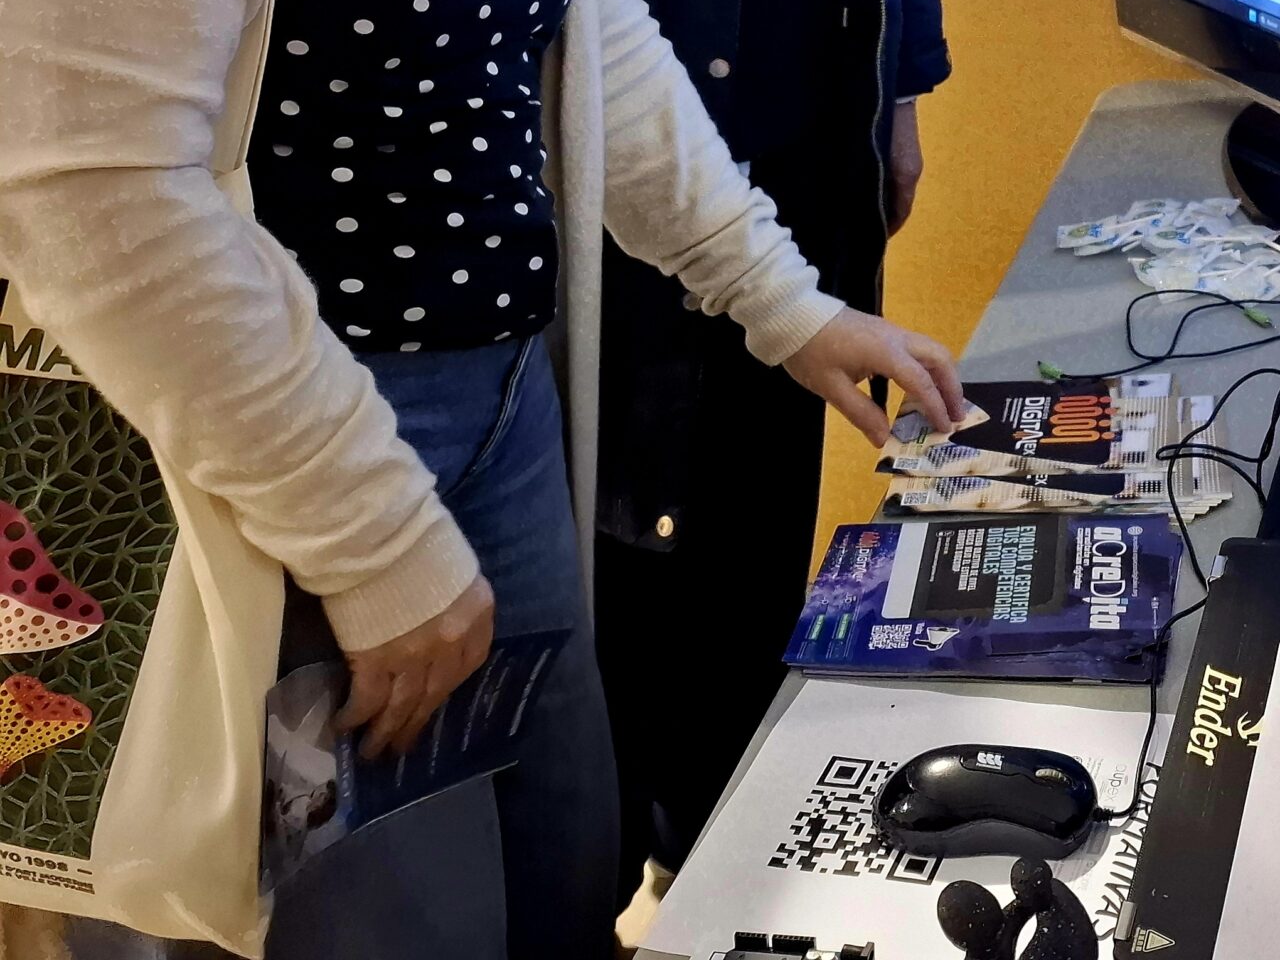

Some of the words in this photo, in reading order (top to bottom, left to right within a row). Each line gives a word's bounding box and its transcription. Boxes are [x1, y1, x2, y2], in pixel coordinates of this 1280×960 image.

[983, 528, 1004, 574] DIGITALES
[1004, 526, 1020, 543] TUS
[1017, 526, 1038, 561] EVALÚA
[993, 548, 1017, 620] COMPETENCIAS
[1009, 575, 1031, 623] CERTIFICA
[1082, 527, 1128, 629] aCreDita
[1186, 664, 1242, 766] Ender
[25, 856, 68, 872] 1998
